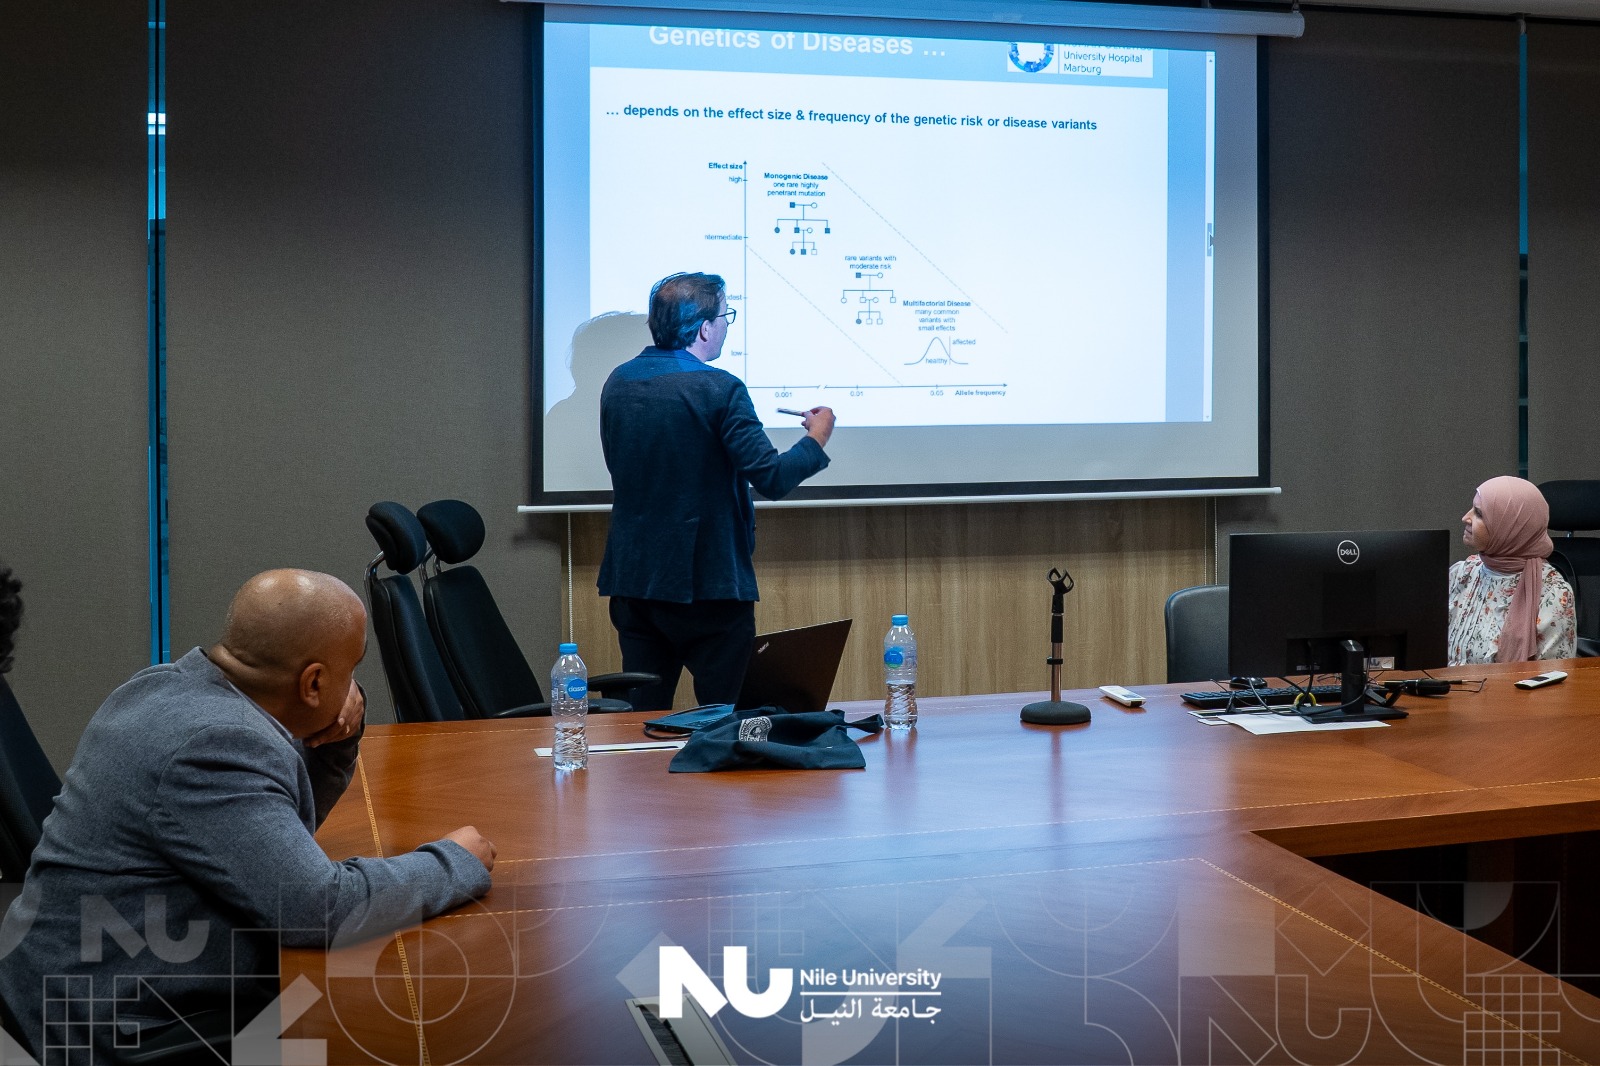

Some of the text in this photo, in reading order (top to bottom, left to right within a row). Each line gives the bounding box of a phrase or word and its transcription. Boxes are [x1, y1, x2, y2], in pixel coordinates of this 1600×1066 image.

[649, 26, 760, 48] Genetics
[771, 34, 795, 50] of
[803, 33, 912, 54] Diseases
[1063, 51, 1143, 63] University Hospital
[1063, 63, 1102, 75] Marburg
[623, 104, 680, 119] depends
[682, 106, 701, 119] on
[703, 106, 725, 120] the
[727, 107, 765, 121] effect
[767, 108, 793, 122] size
[795, 109, 806, 122] &
[808, 110, 872, 125] frequency
[873, 111, 888, 124] of
[890, 112, 911, 126] the
[913, 113, 959, 128] genetic
[960, 114, 984, 127] risk
[986, 116, 1000, 128] or
[1002, 116, 1048, 129] disease
[1051, 118, 1099, 131] variants
[730, 162, 743, 170] size
[764, 172, 829, 181] Monogenic Disease
[800, 182, 819, 191] highly
[767, 189, 826, 198] penetrant mutation
[844, 254, 897, 262] rare variants with
[850, 262, 892, 270] moderate risk
[902, 300, 946, 308] Multifactorial
[918, 316, 956, 324] variants with
[918, 324, 956, 332] small effects
[976, 389, 1006, 397] frequency
